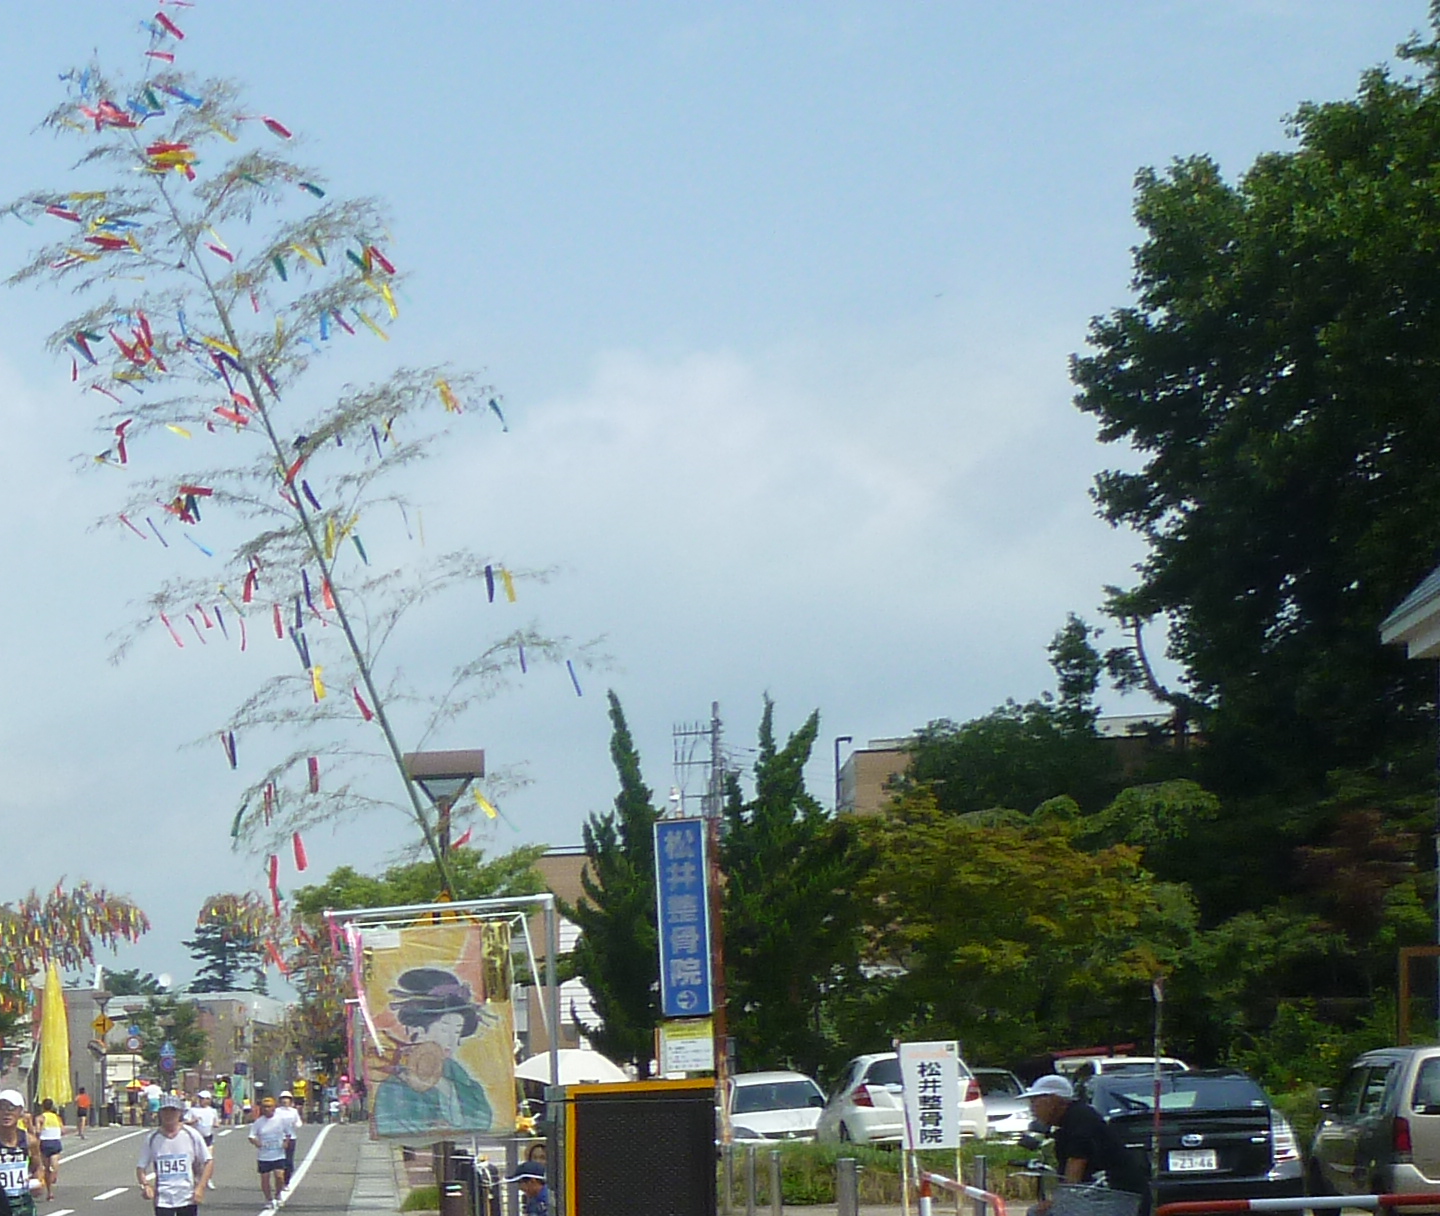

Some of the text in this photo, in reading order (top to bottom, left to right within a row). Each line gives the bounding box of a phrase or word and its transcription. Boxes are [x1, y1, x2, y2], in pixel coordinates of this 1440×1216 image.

[917, 1061, 944, 1145] 松井整骨院
[0, 1170, 25, 1189] 914
